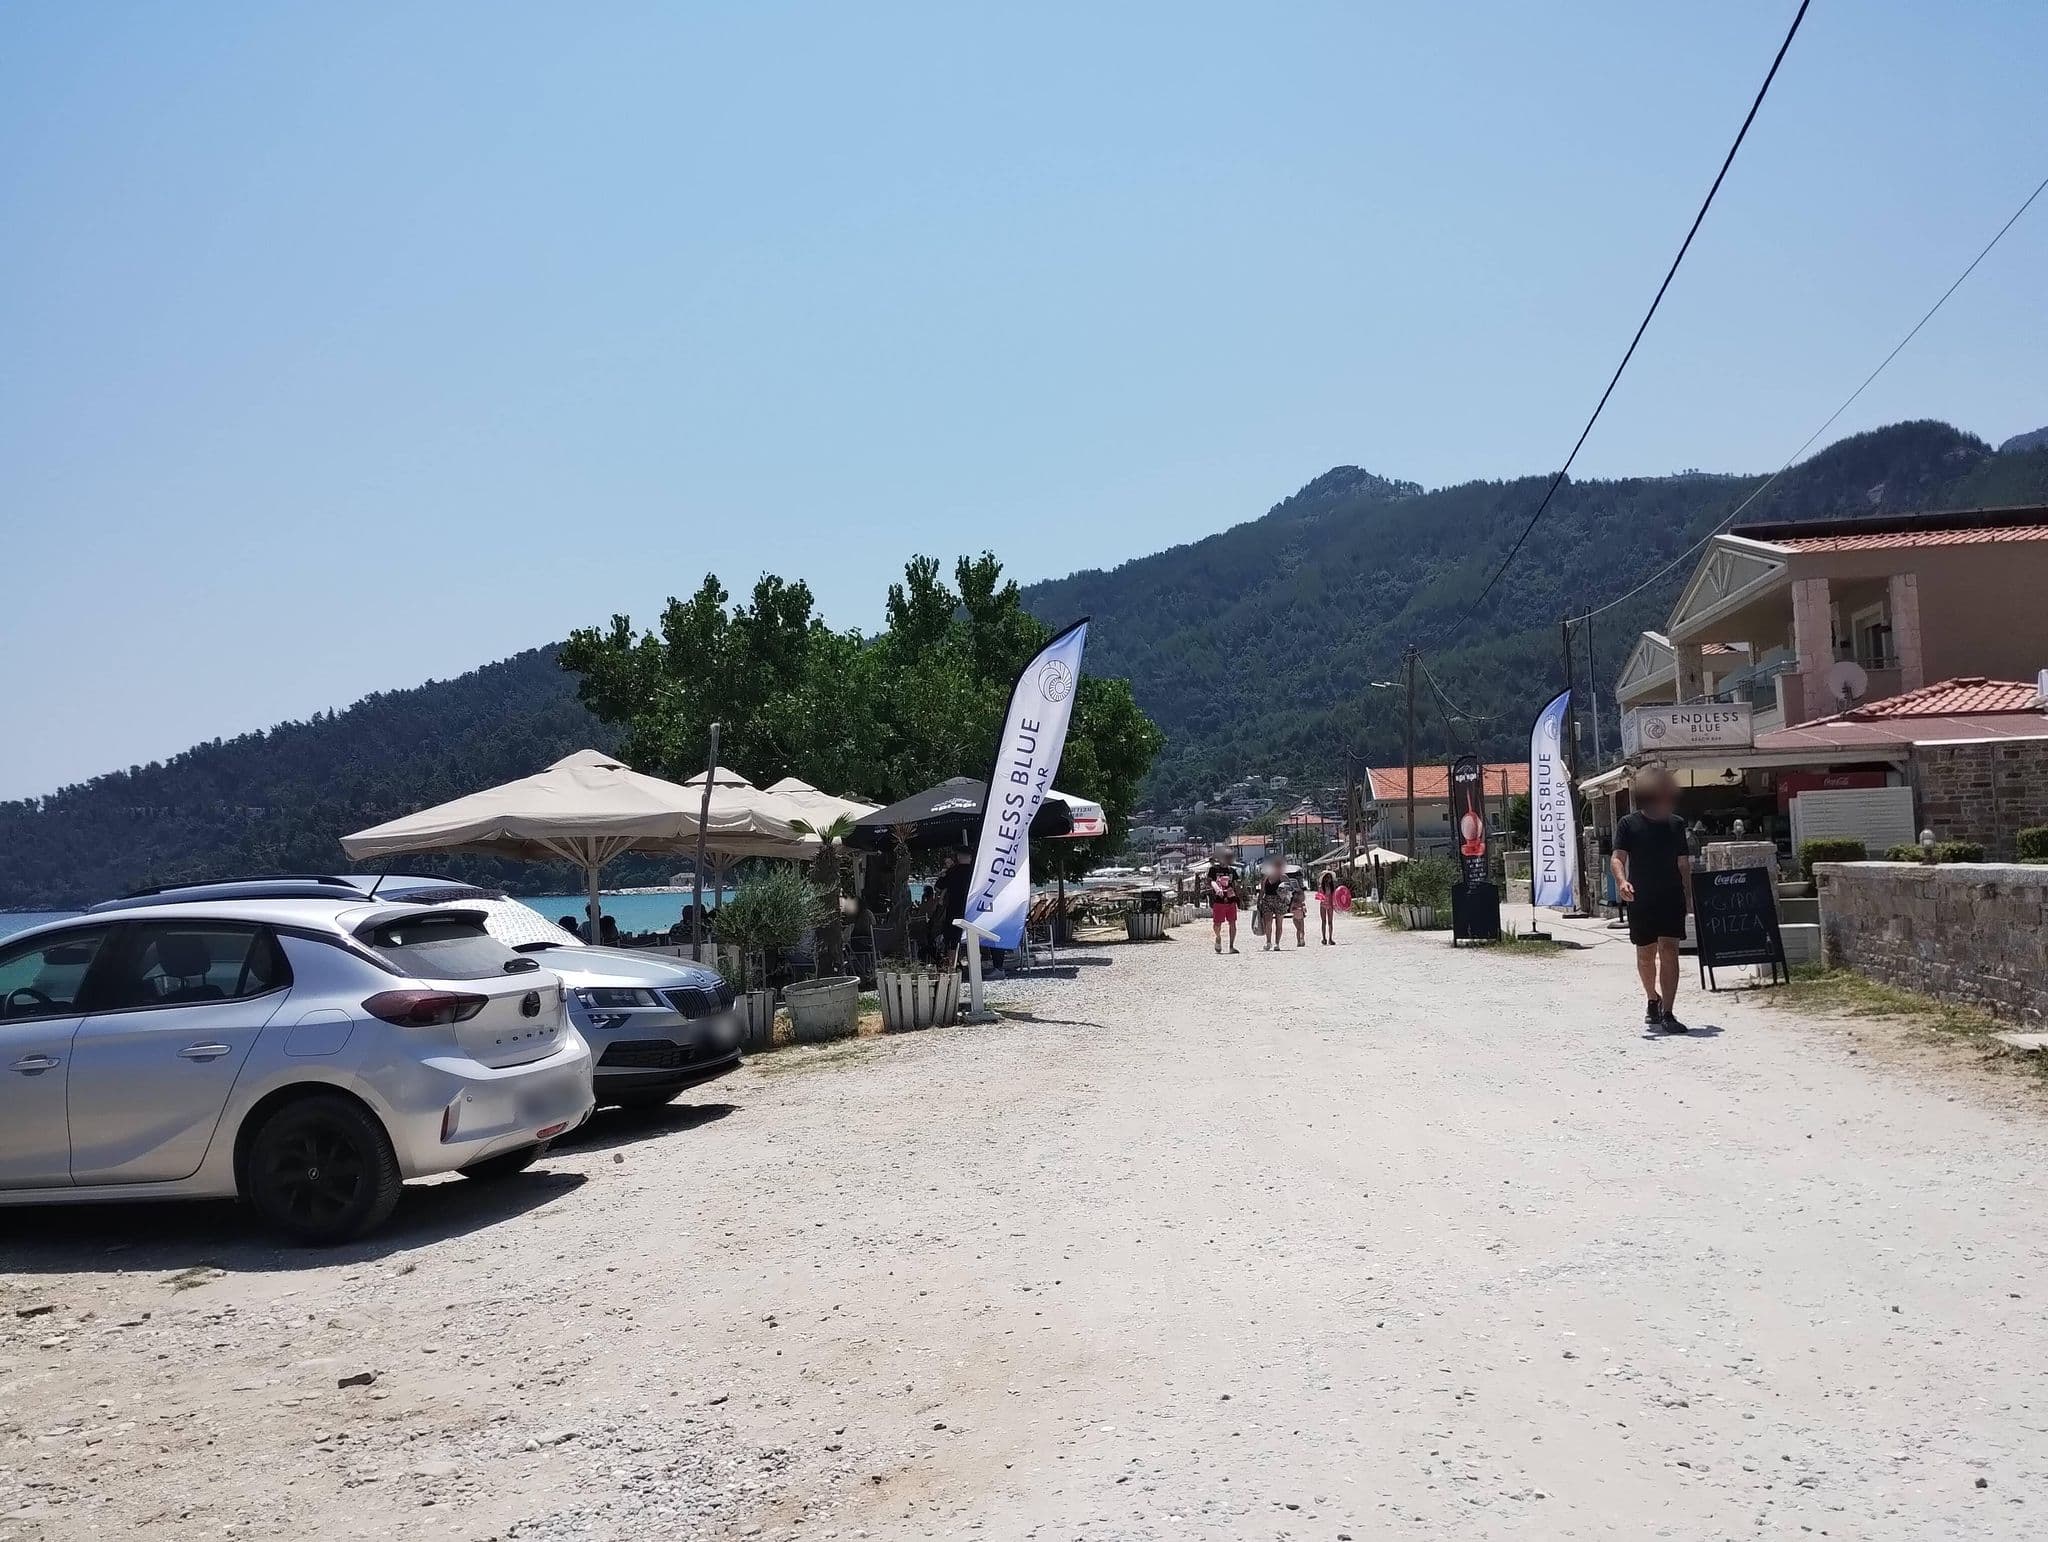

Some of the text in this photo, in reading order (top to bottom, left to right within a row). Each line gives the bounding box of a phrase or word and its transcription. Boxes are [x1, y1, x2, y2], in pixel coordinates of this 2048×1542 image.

[1671, 711, 1739, 725] ENDLESS
[1691, 723, 1721, 733] BLUE
[1031, 767, 1049, 805] BAR
[977, 718, 1041, 913] ENDLESS BLUE
[1539, 753, 1557, 883] ENDLESS BLUE
[1556, 782, 1566, 857] BEACH BAR
[1711, 913, 1765, 934] PIZZA
